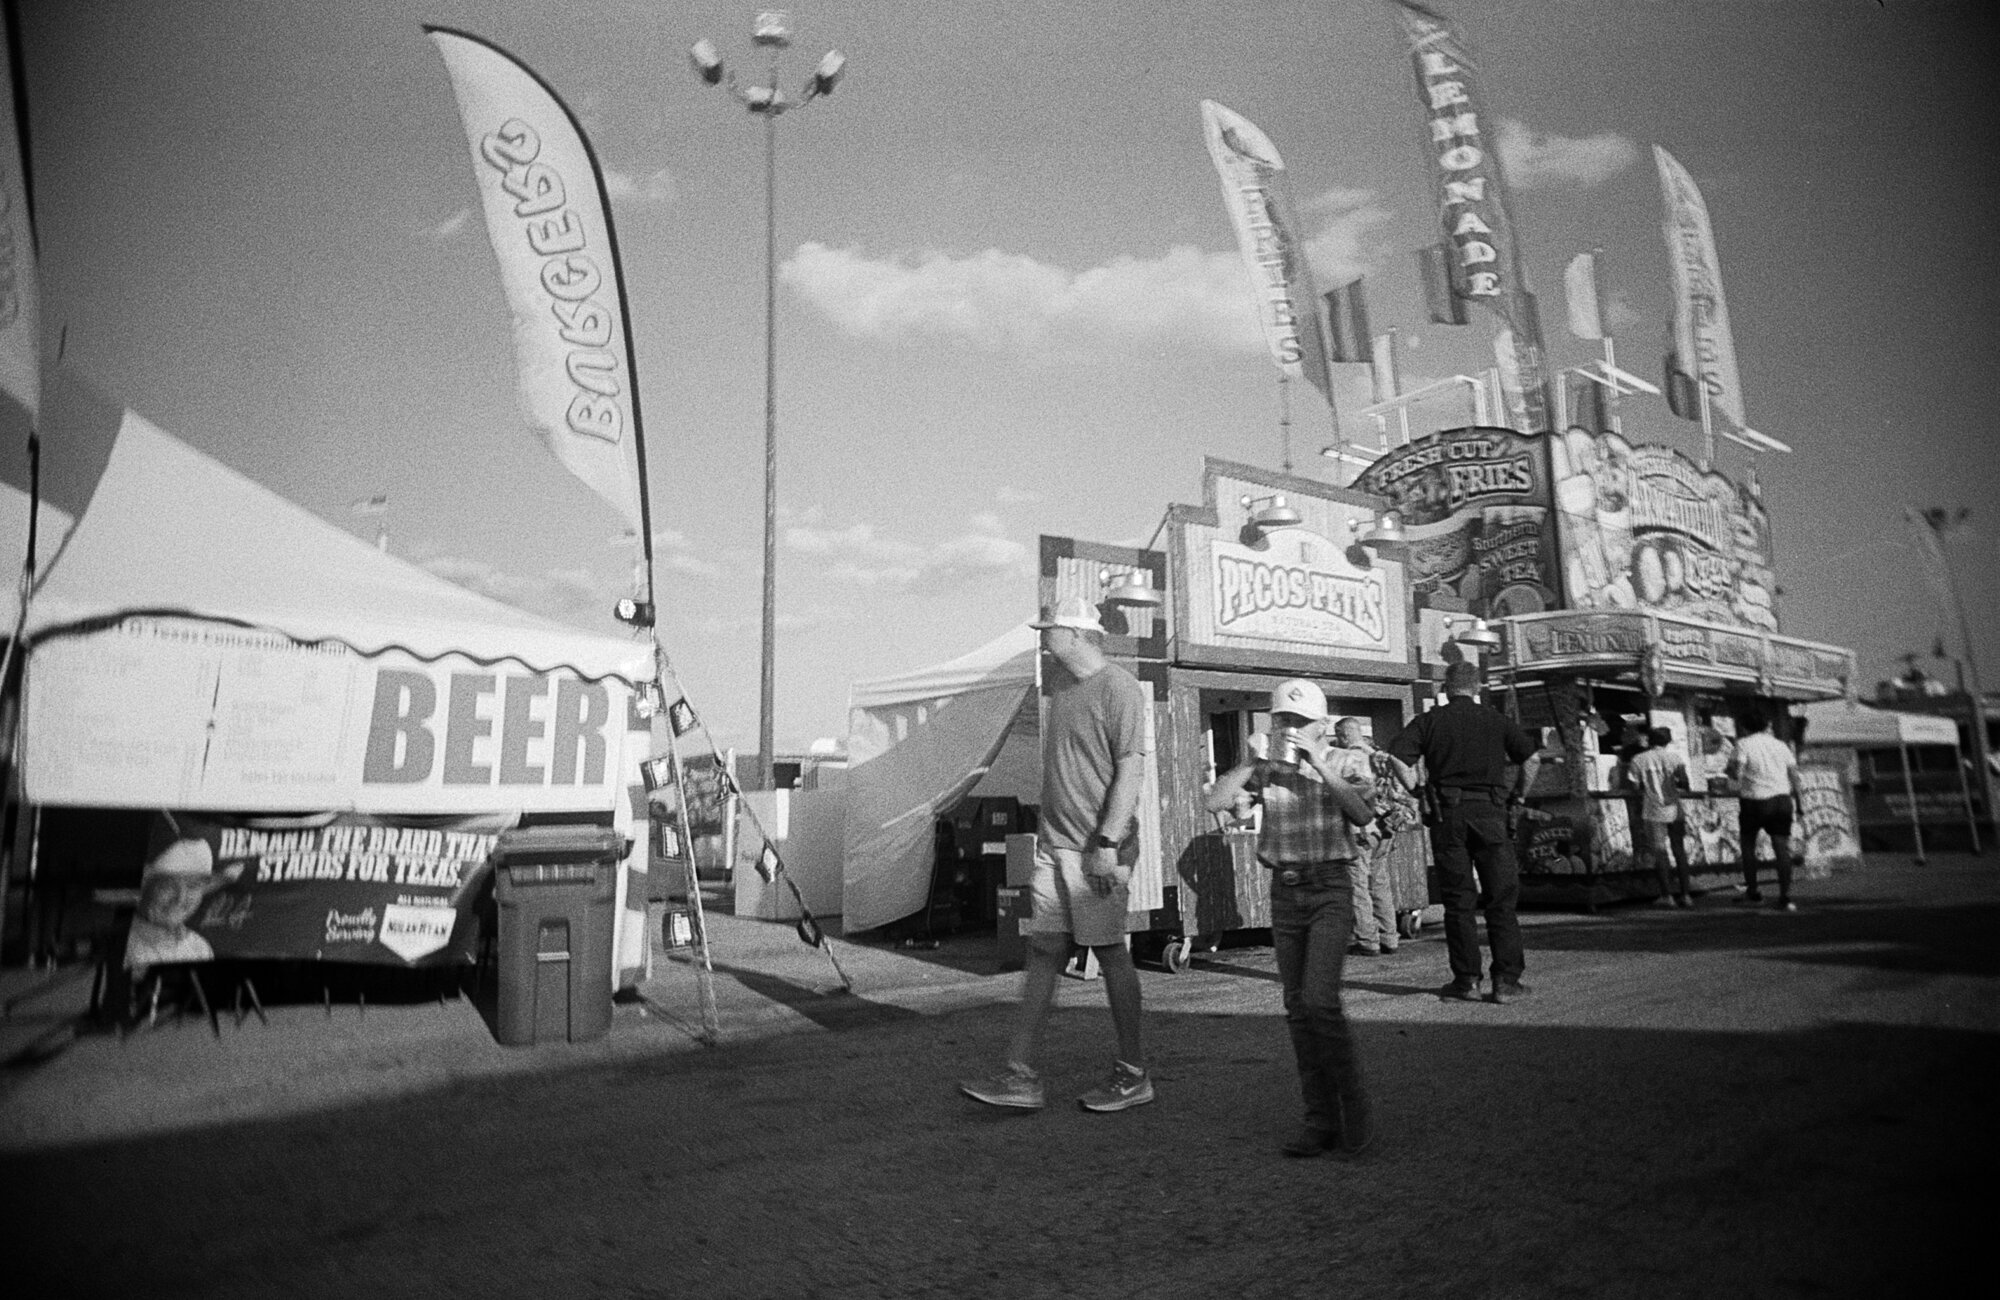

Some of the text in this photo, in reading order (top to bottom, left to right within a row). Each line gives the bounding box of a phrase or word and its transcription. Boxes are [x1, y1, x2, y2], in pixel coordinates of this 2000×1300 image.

[1417, 51, 1501, 296] LEMONADE
[480, 117, 624, 446] BURGERS
[1380, 440, 1493, 488] FRESH CUT
[1449, 456, 1532, 505] FRIES
[1480, 540, 1539, 571] SWEET
[1501, 562, 1542, 582] TEA
[1219, 554, 1308, 625] PECOS
[363, 669, 610, 785] BEER
[219, 828, 315, 859] DEMAND
[321, 826, 367, 855] THE
[369, 828, 442, 858] BRAND
[257, 853, 462, 887] STANDS FOR TEXAS.
